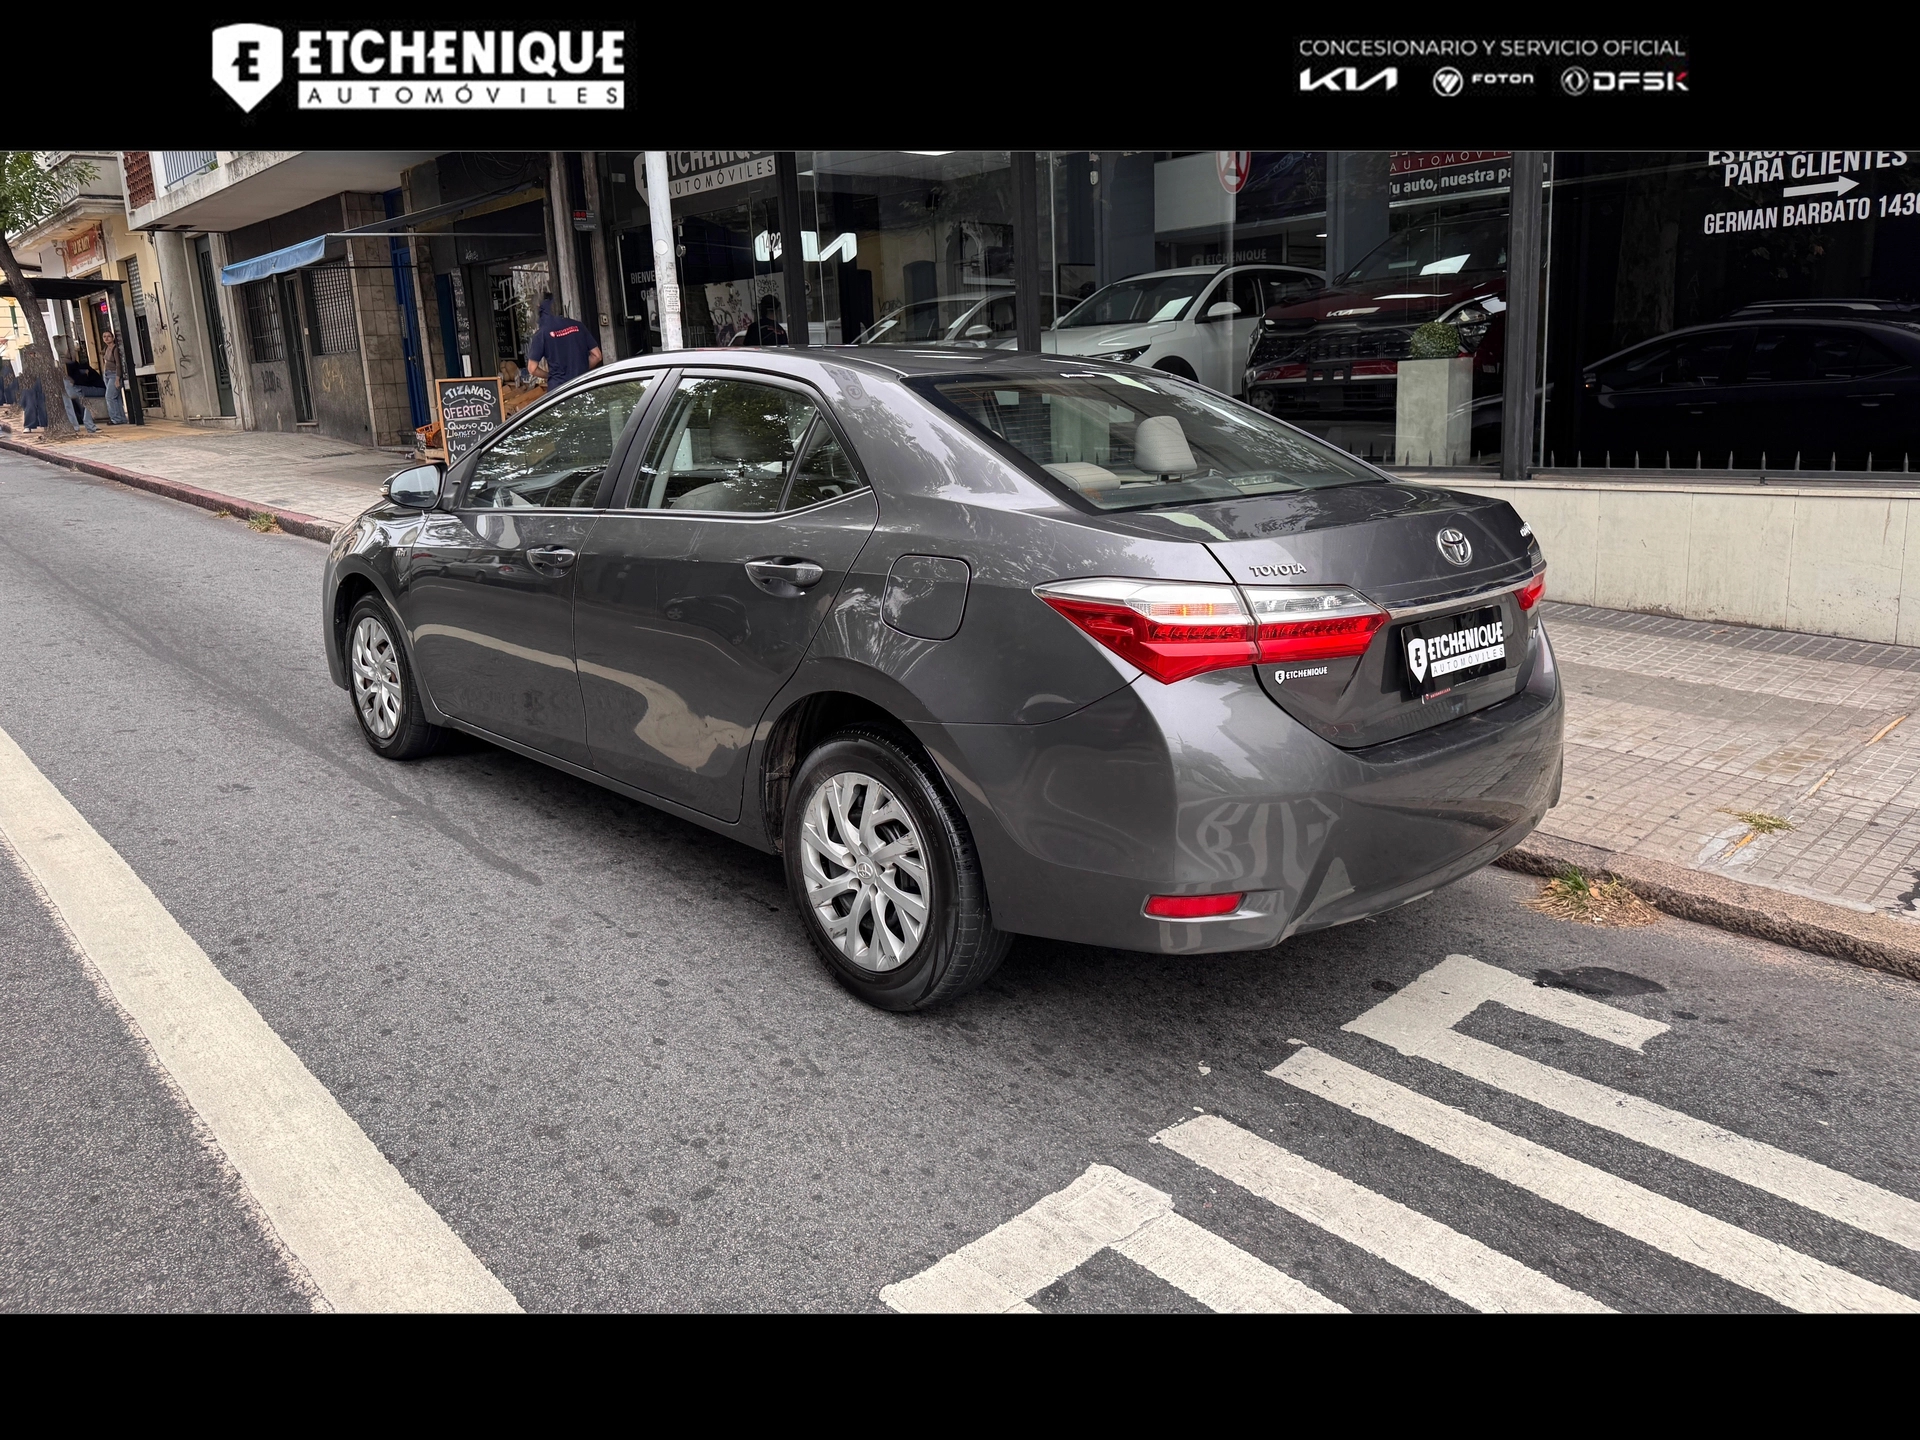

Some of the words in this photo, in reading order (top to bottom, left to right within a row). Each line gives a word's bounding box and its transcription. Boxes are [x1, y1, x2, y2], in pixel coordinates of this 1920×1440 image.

[1724, 158, 1785, 187] PARA
[1791, 151, 1908, 179] CLIENTES
[1403, 178, 1438, 192] auto,
[1441, 169, 1495, 188] nuestra
[1704, 207, 1778, 235] GERMAN
[1783, 197, 1870, 227] BARBATO
[1206, 248, 1267, 264] ETCHENIQUE
[631, 270, 656, 284] BIENVE
[445, 385, 492, 400] TIZANA'S
[444, 404, 491, 419] OFERTAS
[448, 441, 466, 451] Uva
[1249, 563, 1307, 577] TOYOTA
[1428, 621, 1504, 660] ETCHENIQUE
[1286, 666, 1328, 679] ETCHENIQUE
